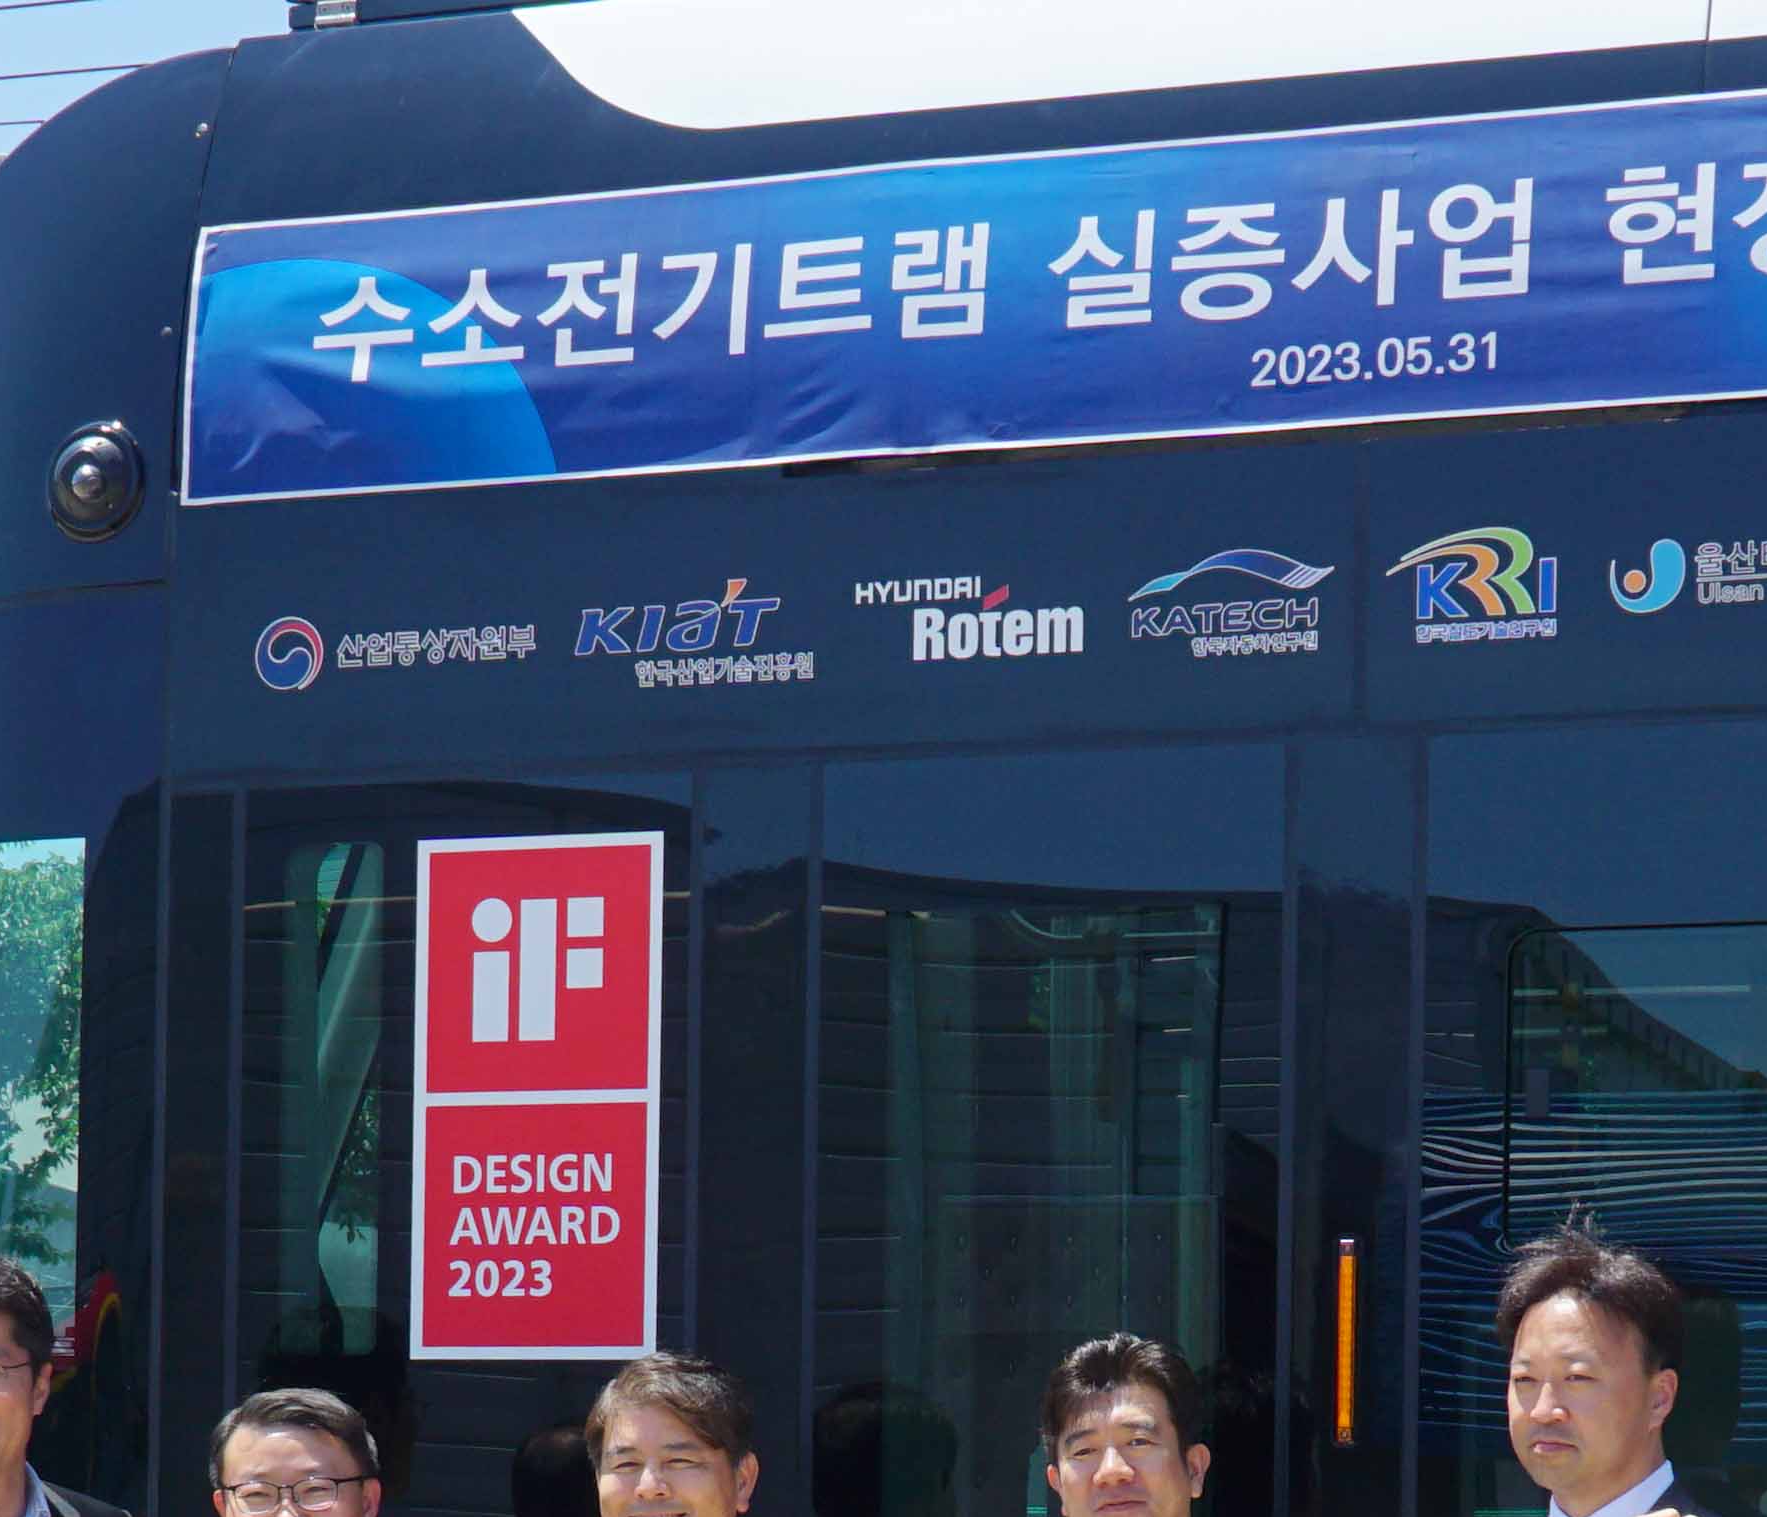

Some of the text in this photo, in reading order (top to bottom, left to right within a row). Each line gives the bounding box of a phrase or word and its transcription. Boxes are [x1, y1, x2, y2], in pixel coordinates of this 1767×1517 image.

[311, 222, 990, 383] 수소전기트램
[1048, 177, 1534, 329] 실증사업
[1250, 331, 1500, 389] 2023.05.31
[855, 575, 981, 605] HYUNDAI
[1697, 581, 1765, 604] Ulsan
[912, 603, 1084, 661] Rotem
[1131, 597, 1319, 638] KATECH
[336, 624, 537, 668] 산업통상자원부
[634, 651, 815, 688] 한국산업기술진흥원
[453, 1152, 613, 1194] DESIGN
[449, 1205, 621, 1246] AWARD
[447, 1259, 553, 1298] 2023
